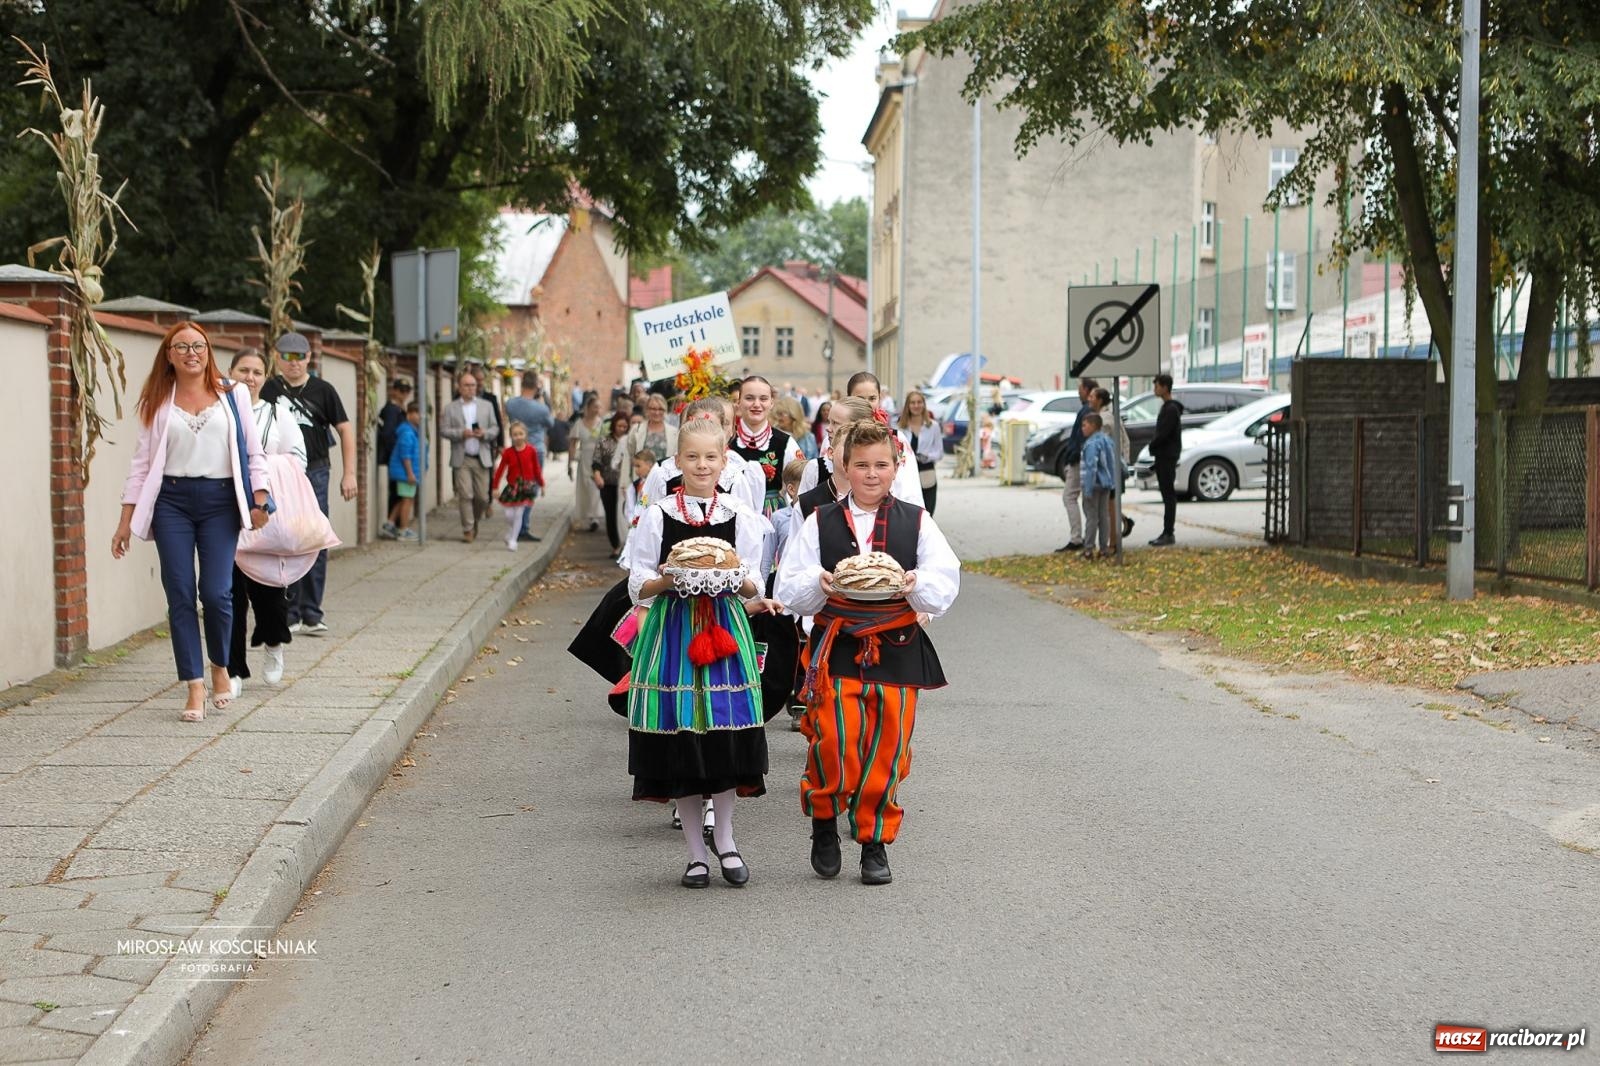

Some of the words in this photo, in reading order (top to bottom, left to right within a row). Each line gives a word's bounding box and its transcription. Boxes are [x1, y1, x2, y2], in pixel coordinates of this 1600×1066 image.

[644, 305, 725, 336] Przedszkole
[1094, 317, 1136, 345] 30
[669, 336, 684, 348] nr
